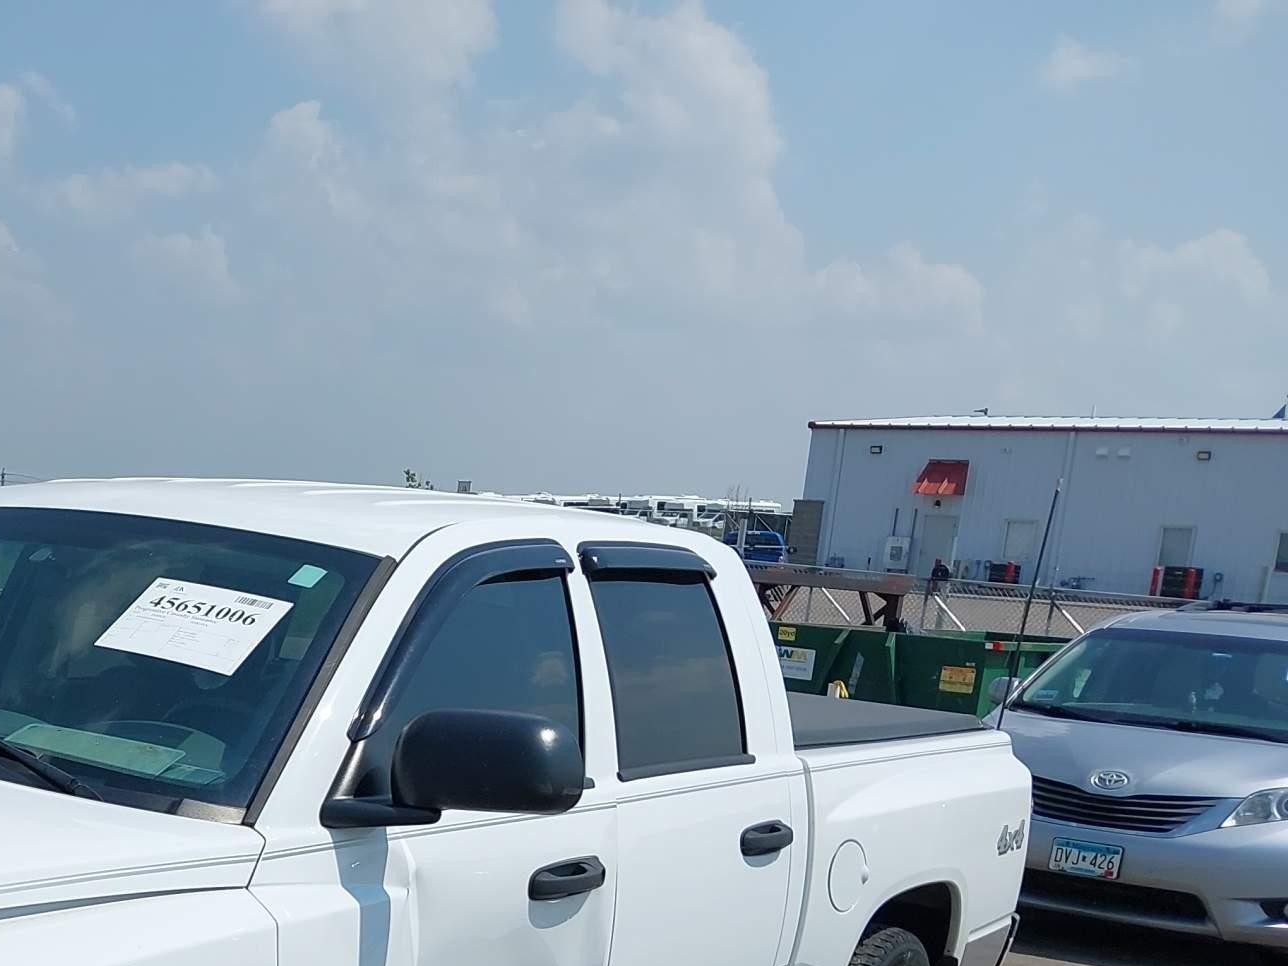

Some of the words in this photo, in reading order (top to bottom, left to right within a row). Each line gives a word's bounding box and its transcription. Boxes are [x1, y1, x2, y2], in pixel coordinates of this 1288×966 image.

[150, 595, 261, 626] 45651006
[1054, 847, 1081, 865] DVJ
[1090, 853, 1115, 871] 426
